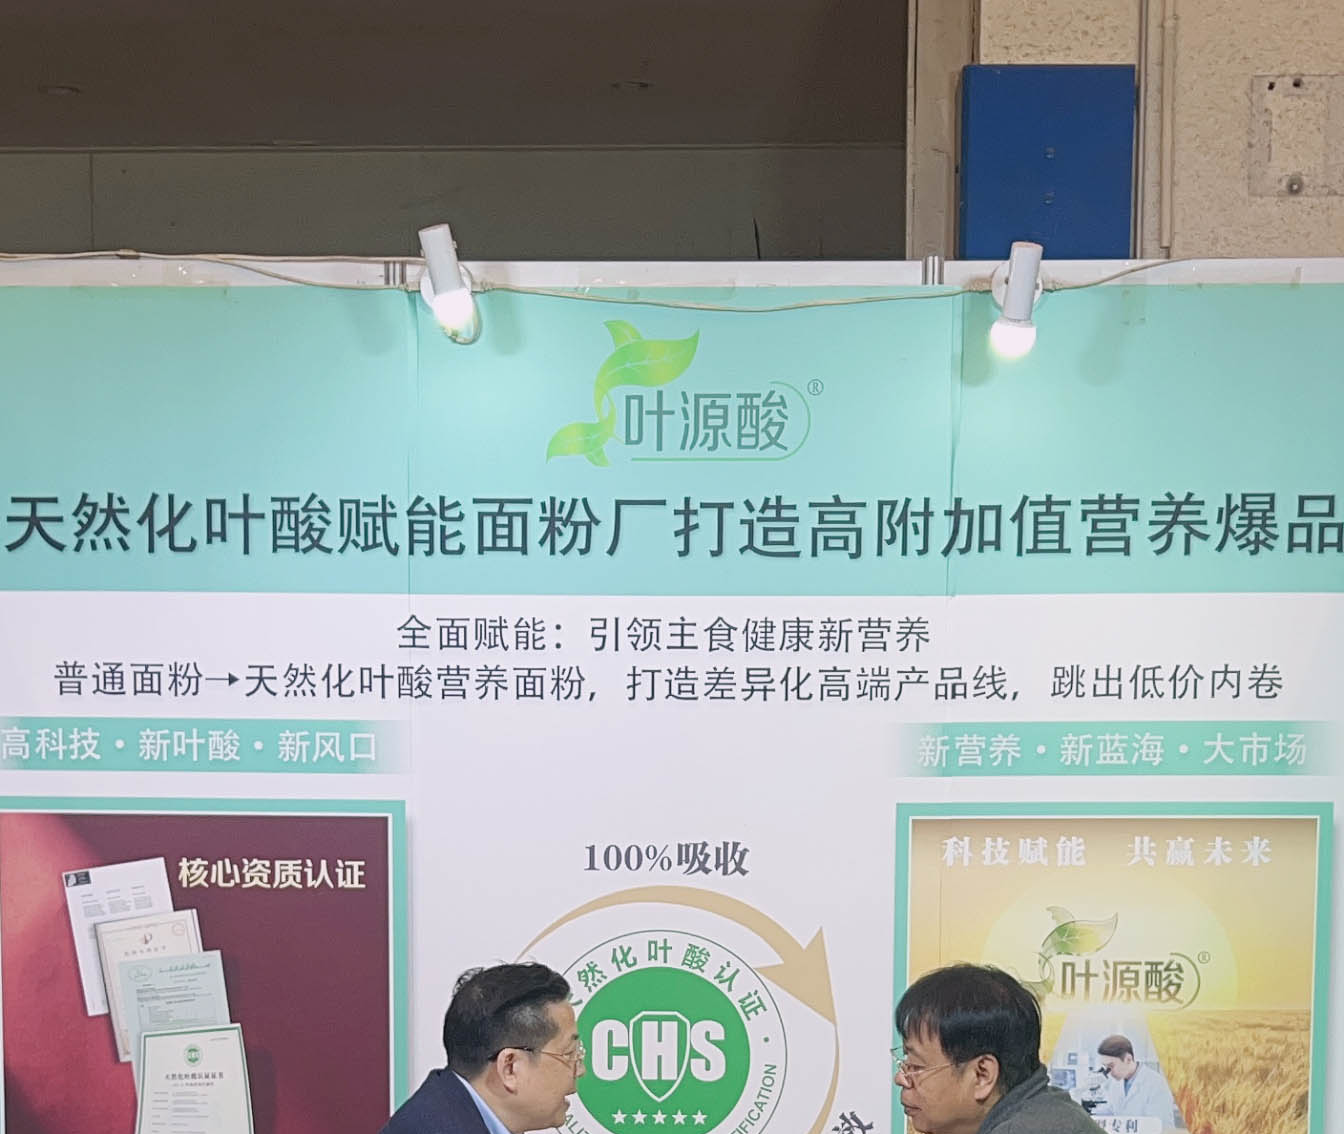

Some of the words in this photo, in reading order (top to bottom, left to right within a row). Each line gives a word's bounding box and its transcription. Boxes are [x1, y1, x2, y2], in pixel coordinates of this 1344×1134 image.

[397, 615, 930, 653] 全面赋能：引领主食健康新营养
[583, 841, 750, 876] 100%吸收
[941, 836, 1087, 867] 科技赋能
[1128, 836, 1273, 867] 共赢未来
[178, 857, 366, 890] 核心资质认证
[567, 938, 768, 1022] 然化叶酸认证
[1061, 959, 1185, 1005] 叶源酸
[591, 1019, 726, 1081] CHS
